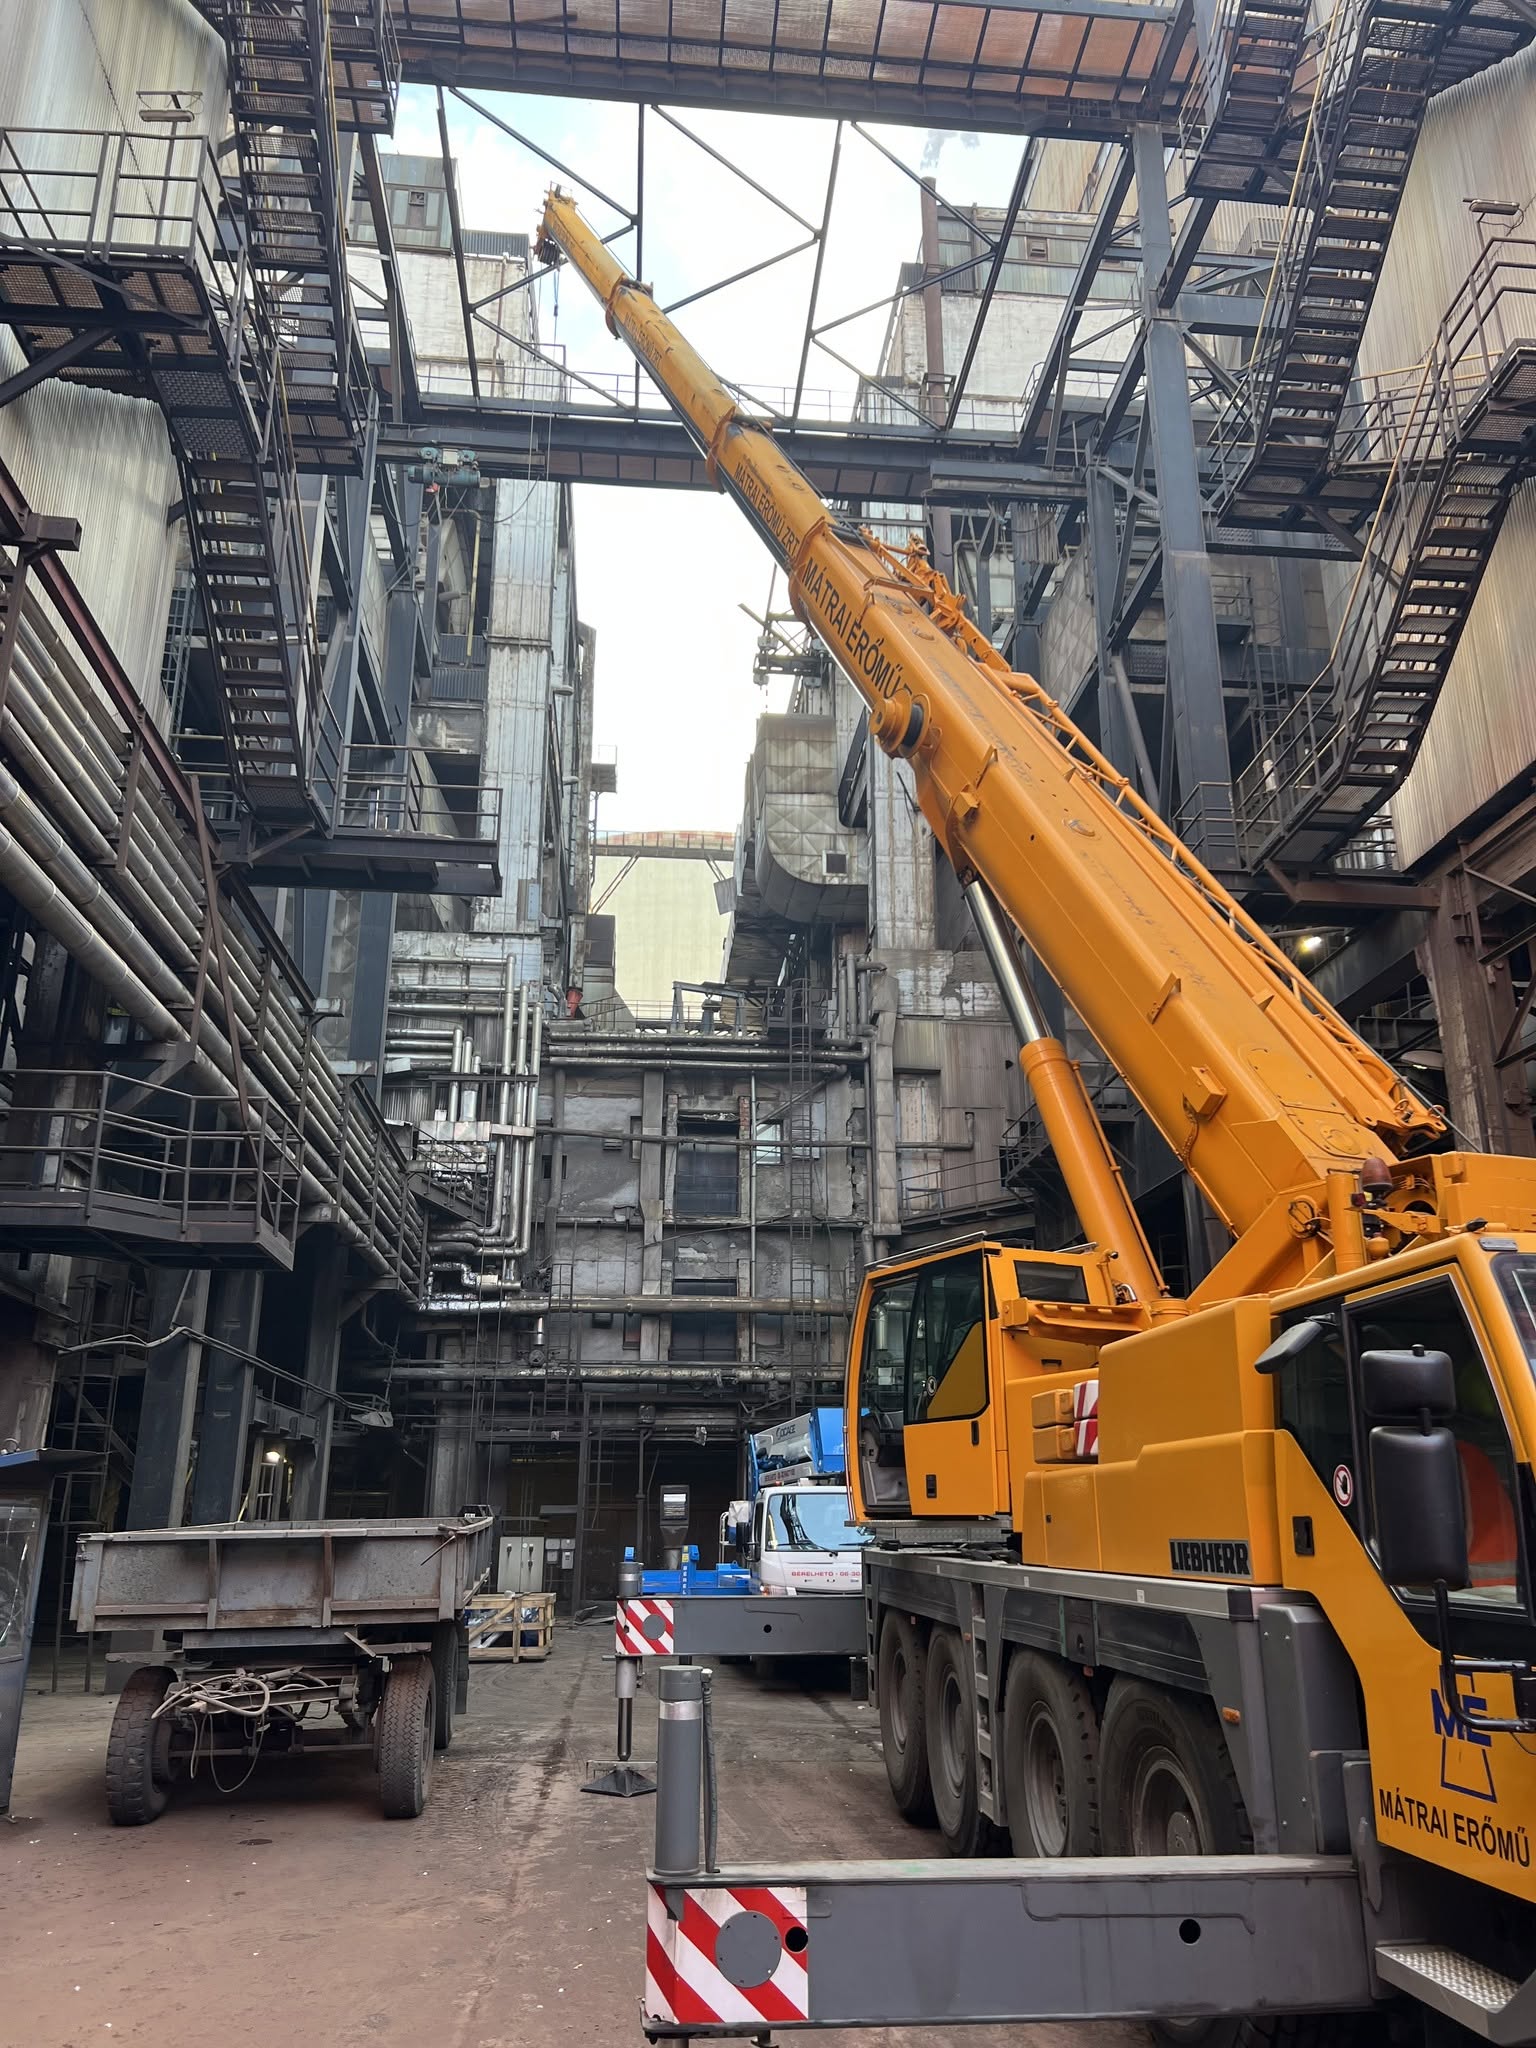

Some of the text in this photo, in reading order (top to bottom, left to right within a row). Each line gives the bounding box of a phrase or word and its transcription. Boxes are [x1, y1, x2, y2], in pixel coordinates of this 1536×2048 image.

[802, 557, 903, 699] MÁTRAI ERŐMŰ
[1170, 1541, 1250, 1575] LIEBHERR
[1379, 1787, 1530, 1867] MÁTRAI ERŐMŰ
